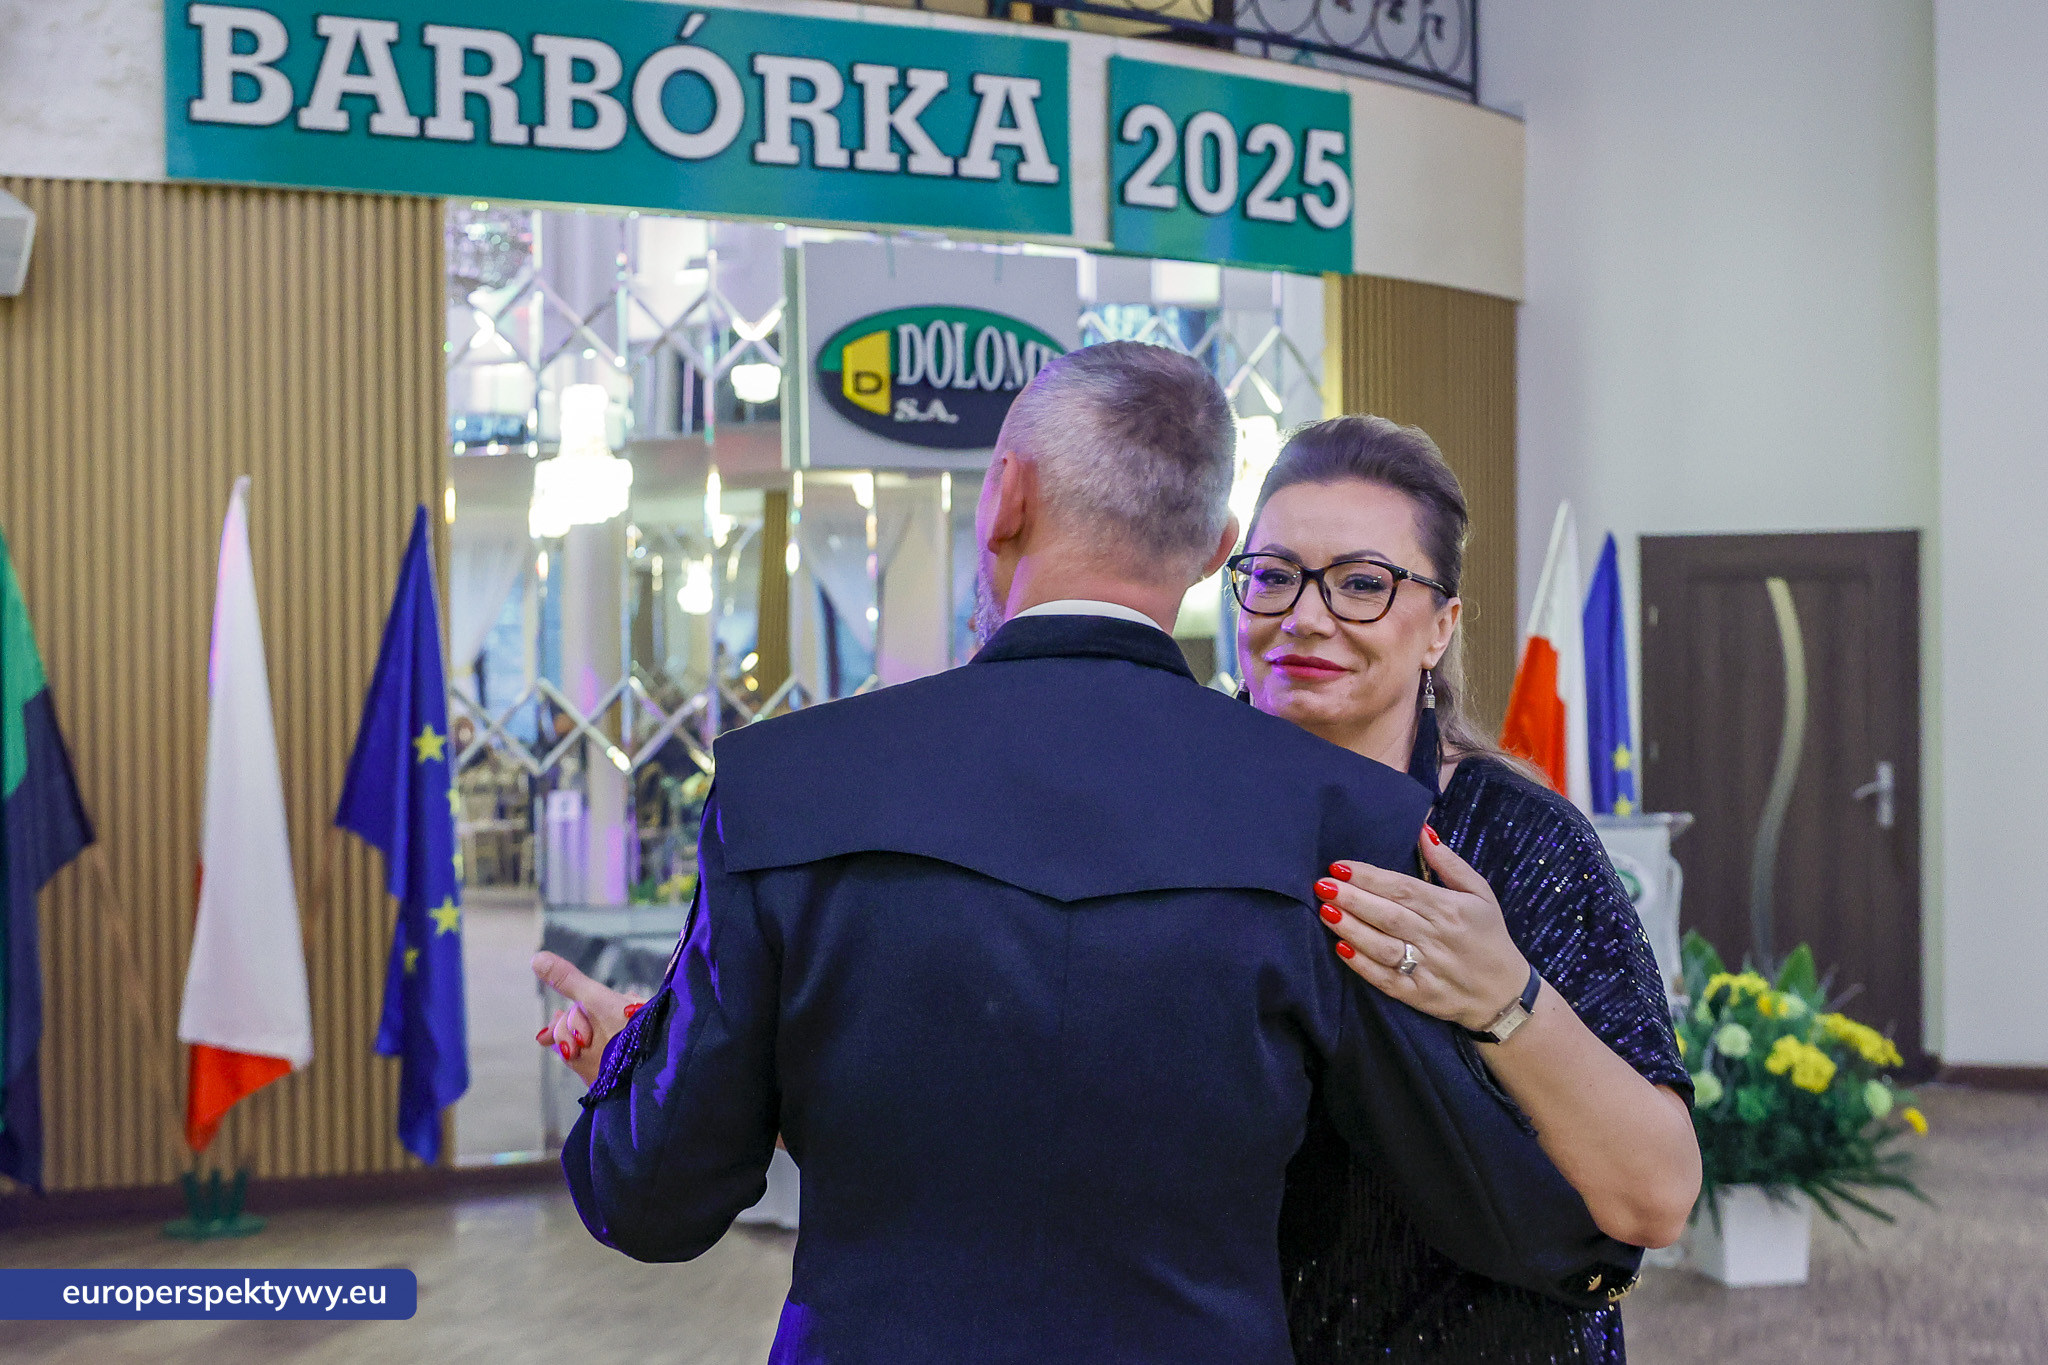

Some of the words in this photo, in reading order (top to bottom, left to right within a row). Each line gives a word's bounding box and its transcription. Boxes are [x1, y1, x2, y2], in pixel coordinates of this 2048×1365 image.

[188, 3, 1060, 184] BARBÓRKA
[1121, 103, 1353, 230] 2025
[893, 397, 960, 425] S.A.
